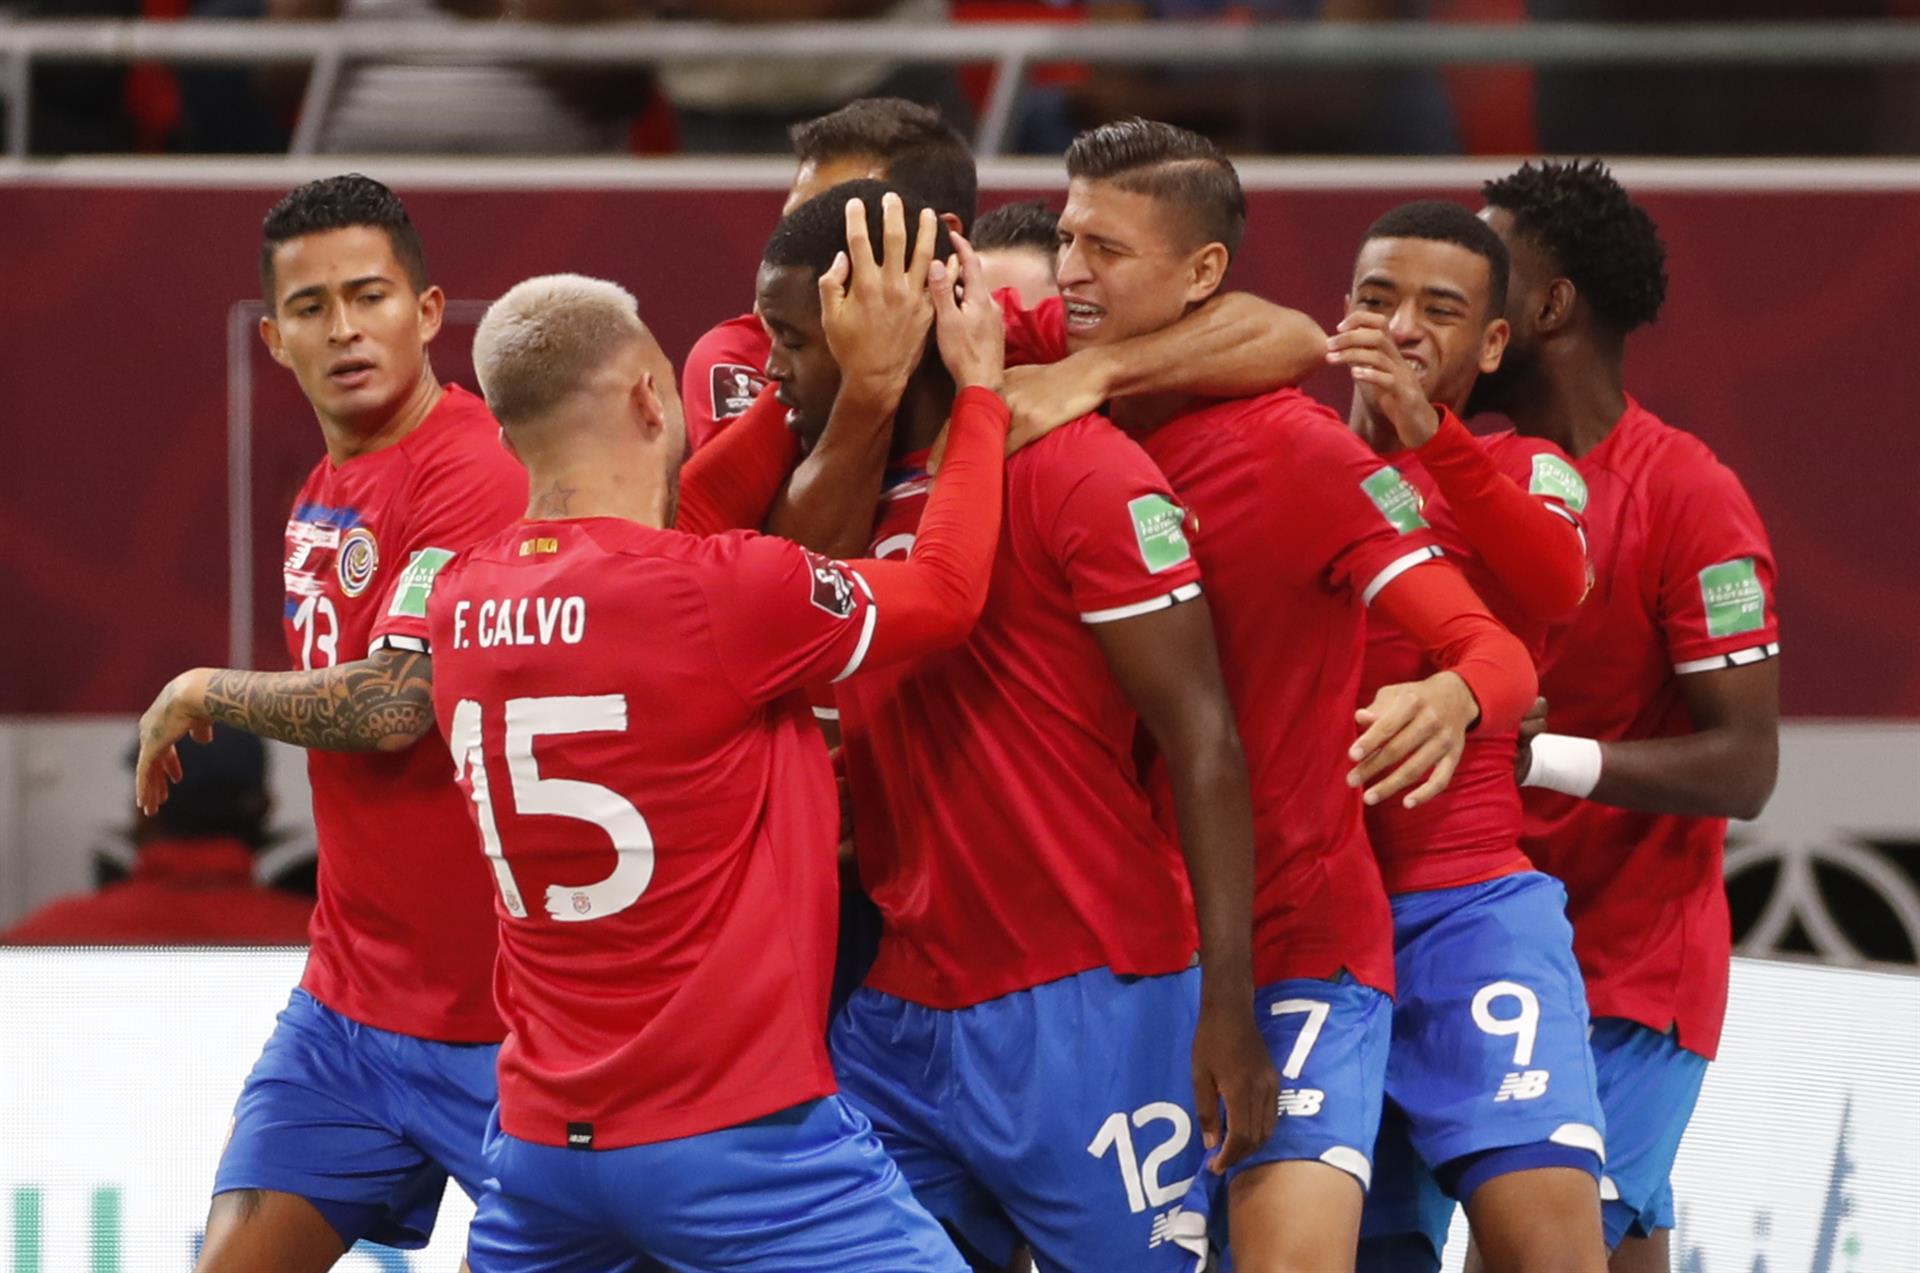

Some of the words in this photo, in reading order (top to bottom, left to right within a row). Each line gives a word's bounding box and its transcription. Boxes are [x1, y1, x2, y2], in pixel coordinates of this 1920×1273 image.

[292, 595, 339, 672] 13
[453, 600, 471, 649] F.
[478, 596, 586, 648] CALVO
[451, 693, 656, 922] 15
[1270, 998, 1331, 1080] 7
[1470, 980, 1540, 1067] 9
[1492, 1069, 1550, 1103] NB
[1086, 1101, 1197, 1214] 12
